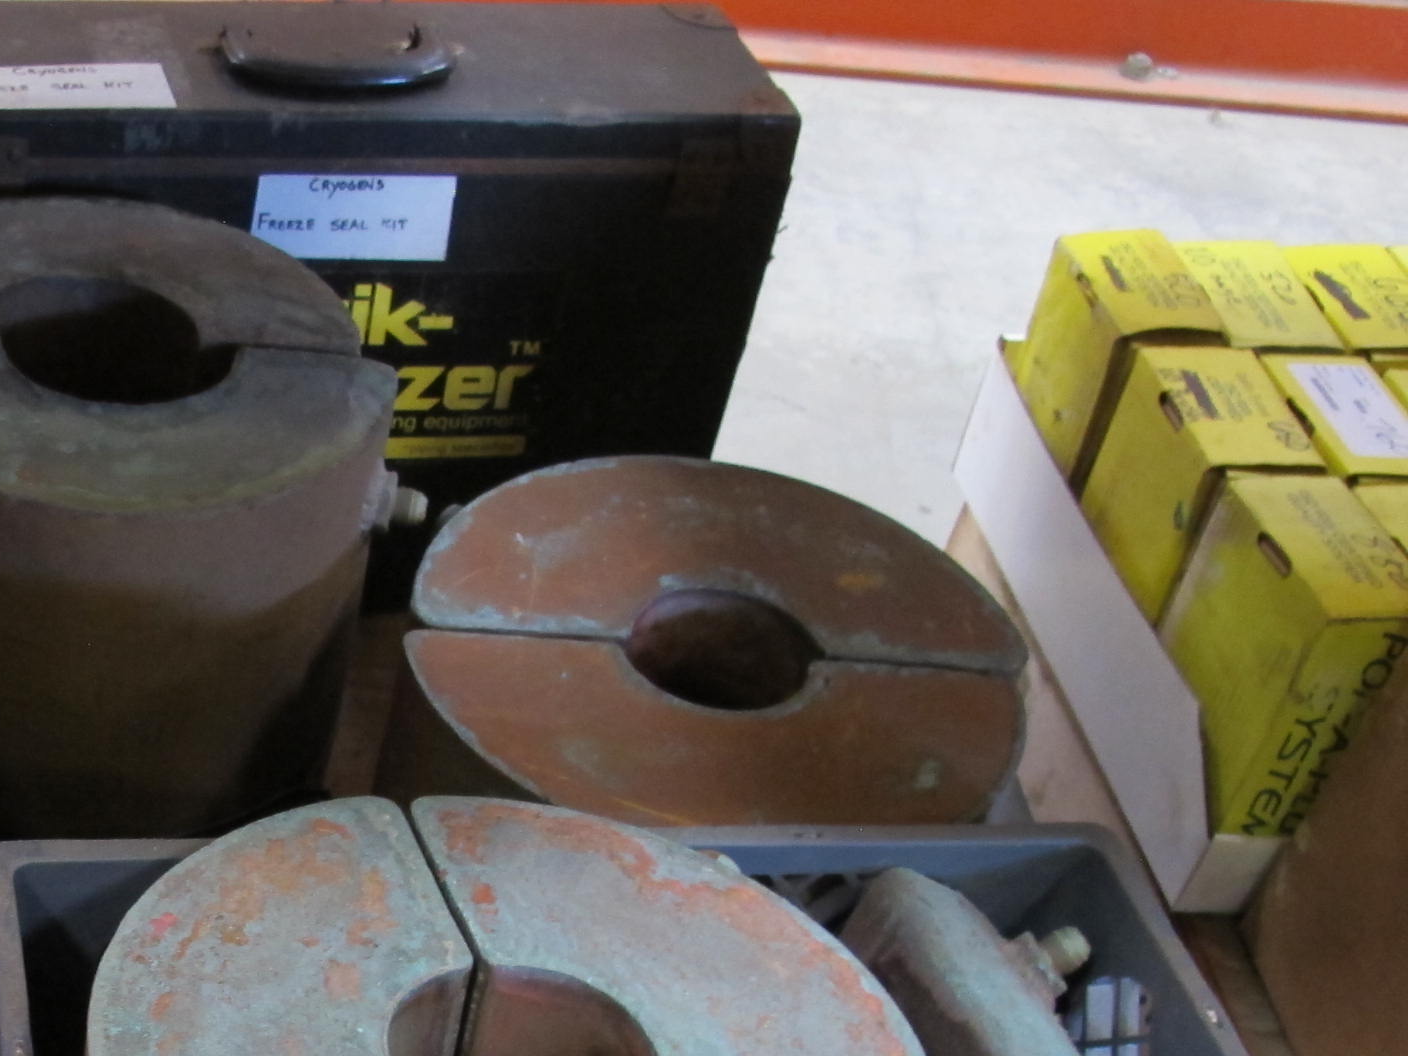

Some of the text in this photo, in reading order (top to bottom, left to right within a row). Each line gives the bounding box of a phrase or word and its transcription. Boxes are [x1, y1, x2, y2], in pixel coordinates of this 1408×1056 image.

[50, 82, 88, 91] SEAL
[257, 213, 409, 232] FREEZE SEAL KIT
[346, 282, 454, 347] ik-
